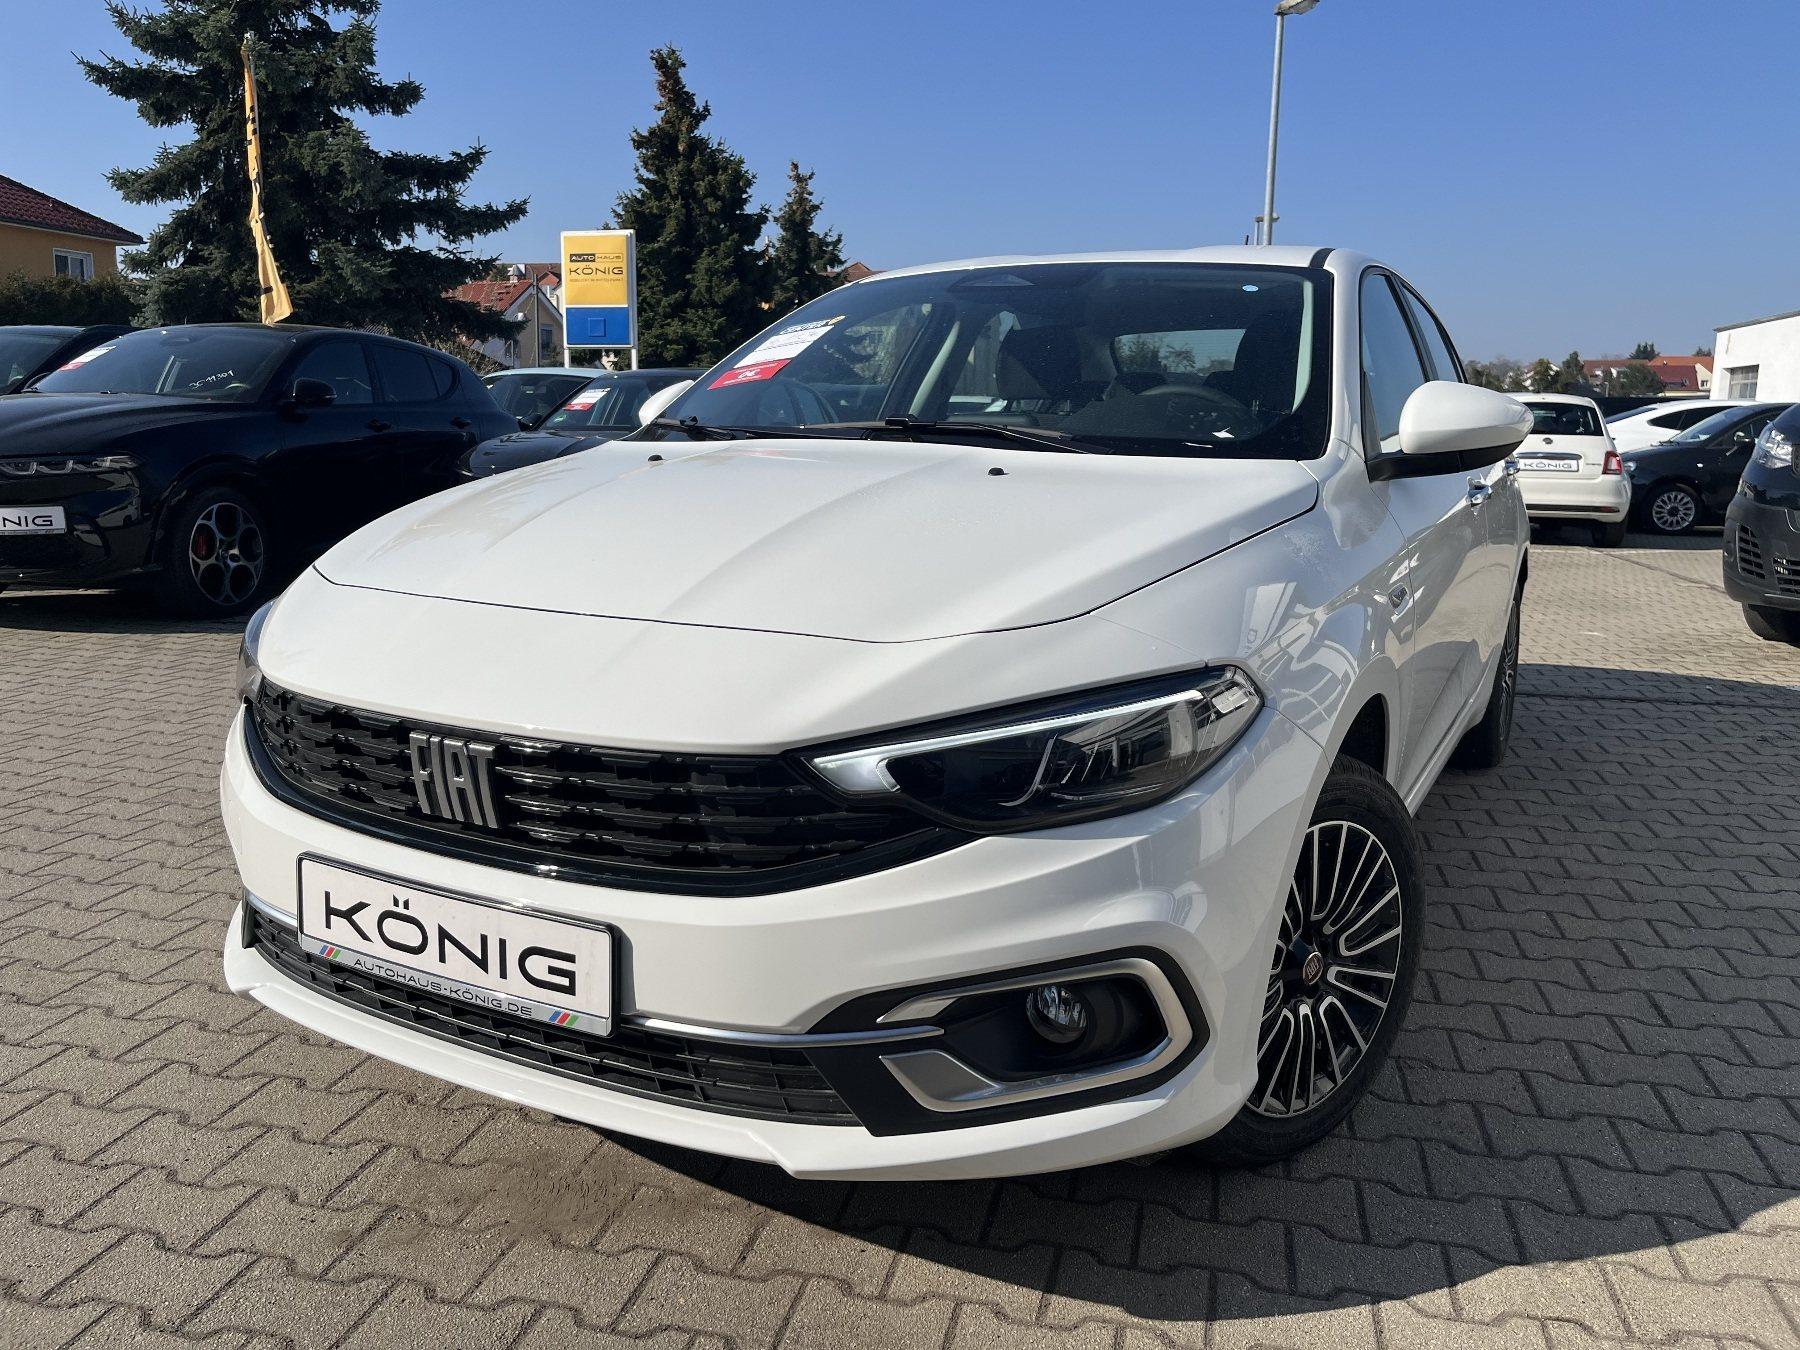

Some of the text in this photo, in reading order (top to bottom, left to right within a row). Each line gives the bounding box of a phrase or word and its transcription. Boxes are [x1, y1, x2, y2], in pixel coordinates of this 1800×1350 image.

[569, 265, 624, 275] KÖNIG
[409, 730, 499, 829] FIAT
[324, 890, 577, 997] KÖNIG
[353, 958, 533, 1017] AUTOHAUS-KÖNIG.DE
